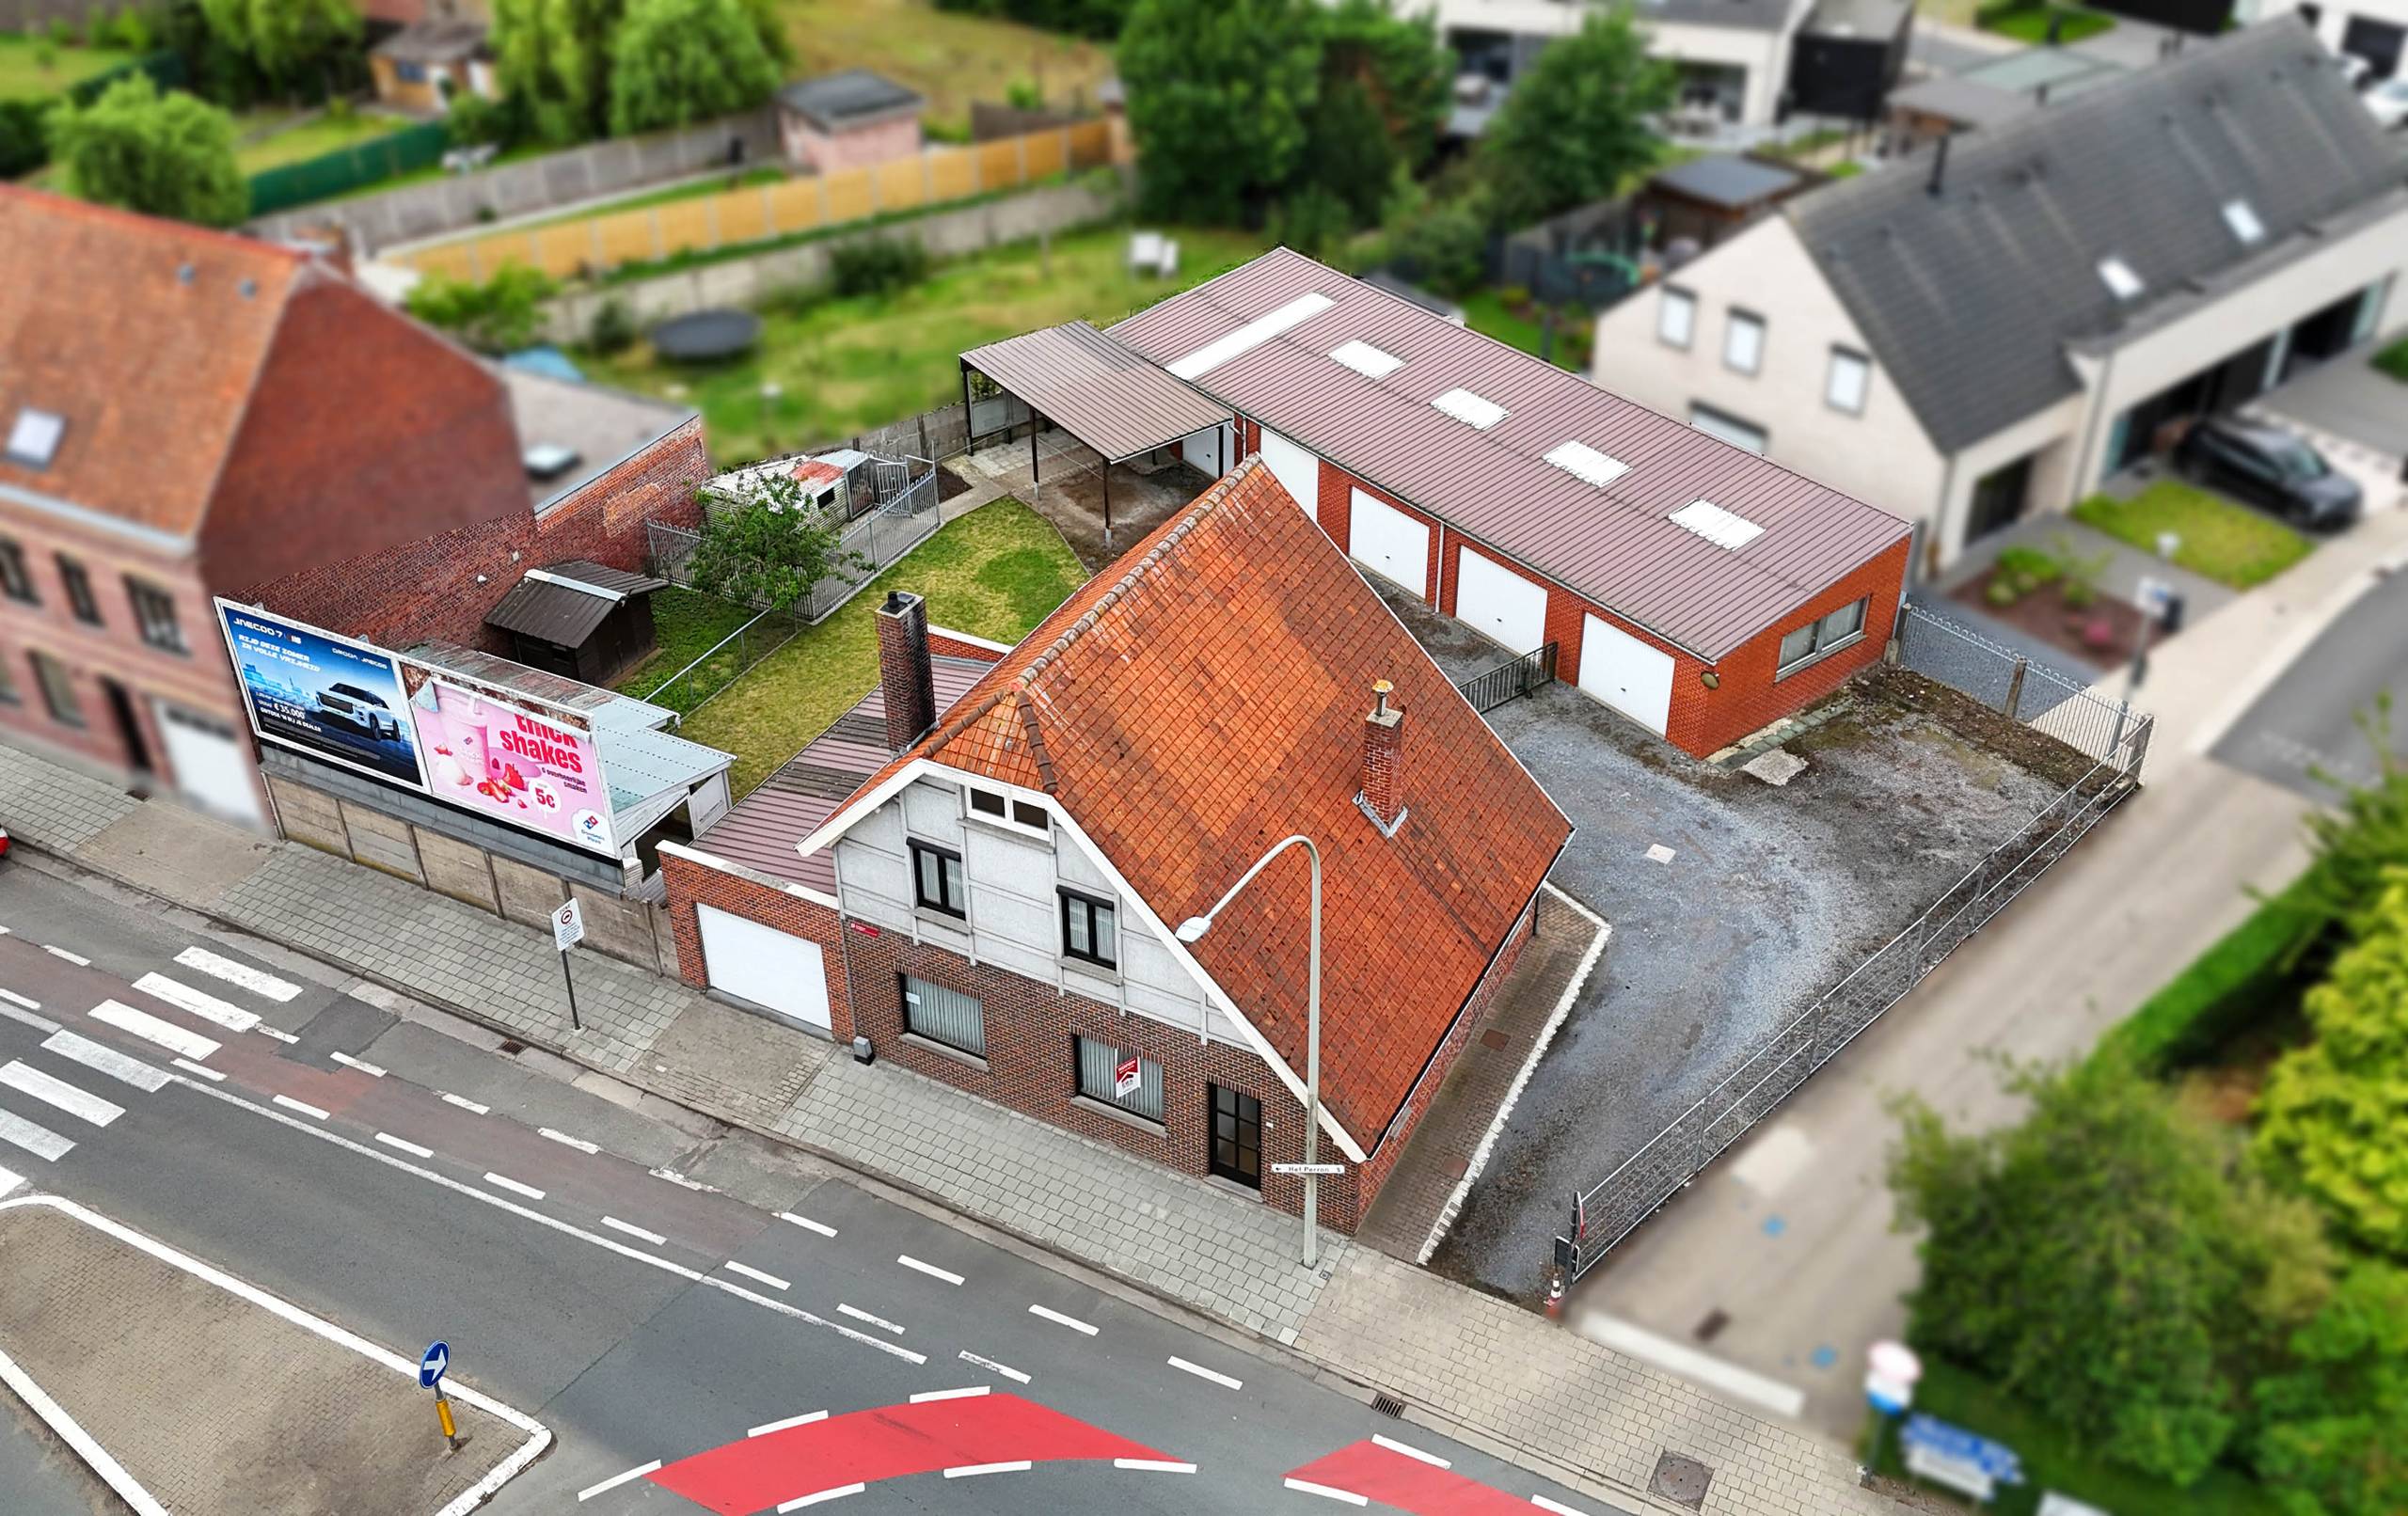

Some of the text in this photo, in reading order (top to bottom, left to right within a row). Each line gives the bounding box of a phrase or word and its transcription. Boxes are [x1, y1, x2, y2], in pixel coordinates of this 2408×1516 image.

[253, 645, 278, 658] VOLLE
[279, 654, 322, 671] VRIJHEID
[282, 647, 310, 662] ZOMER
[499, 730, 583, 773] shakes
